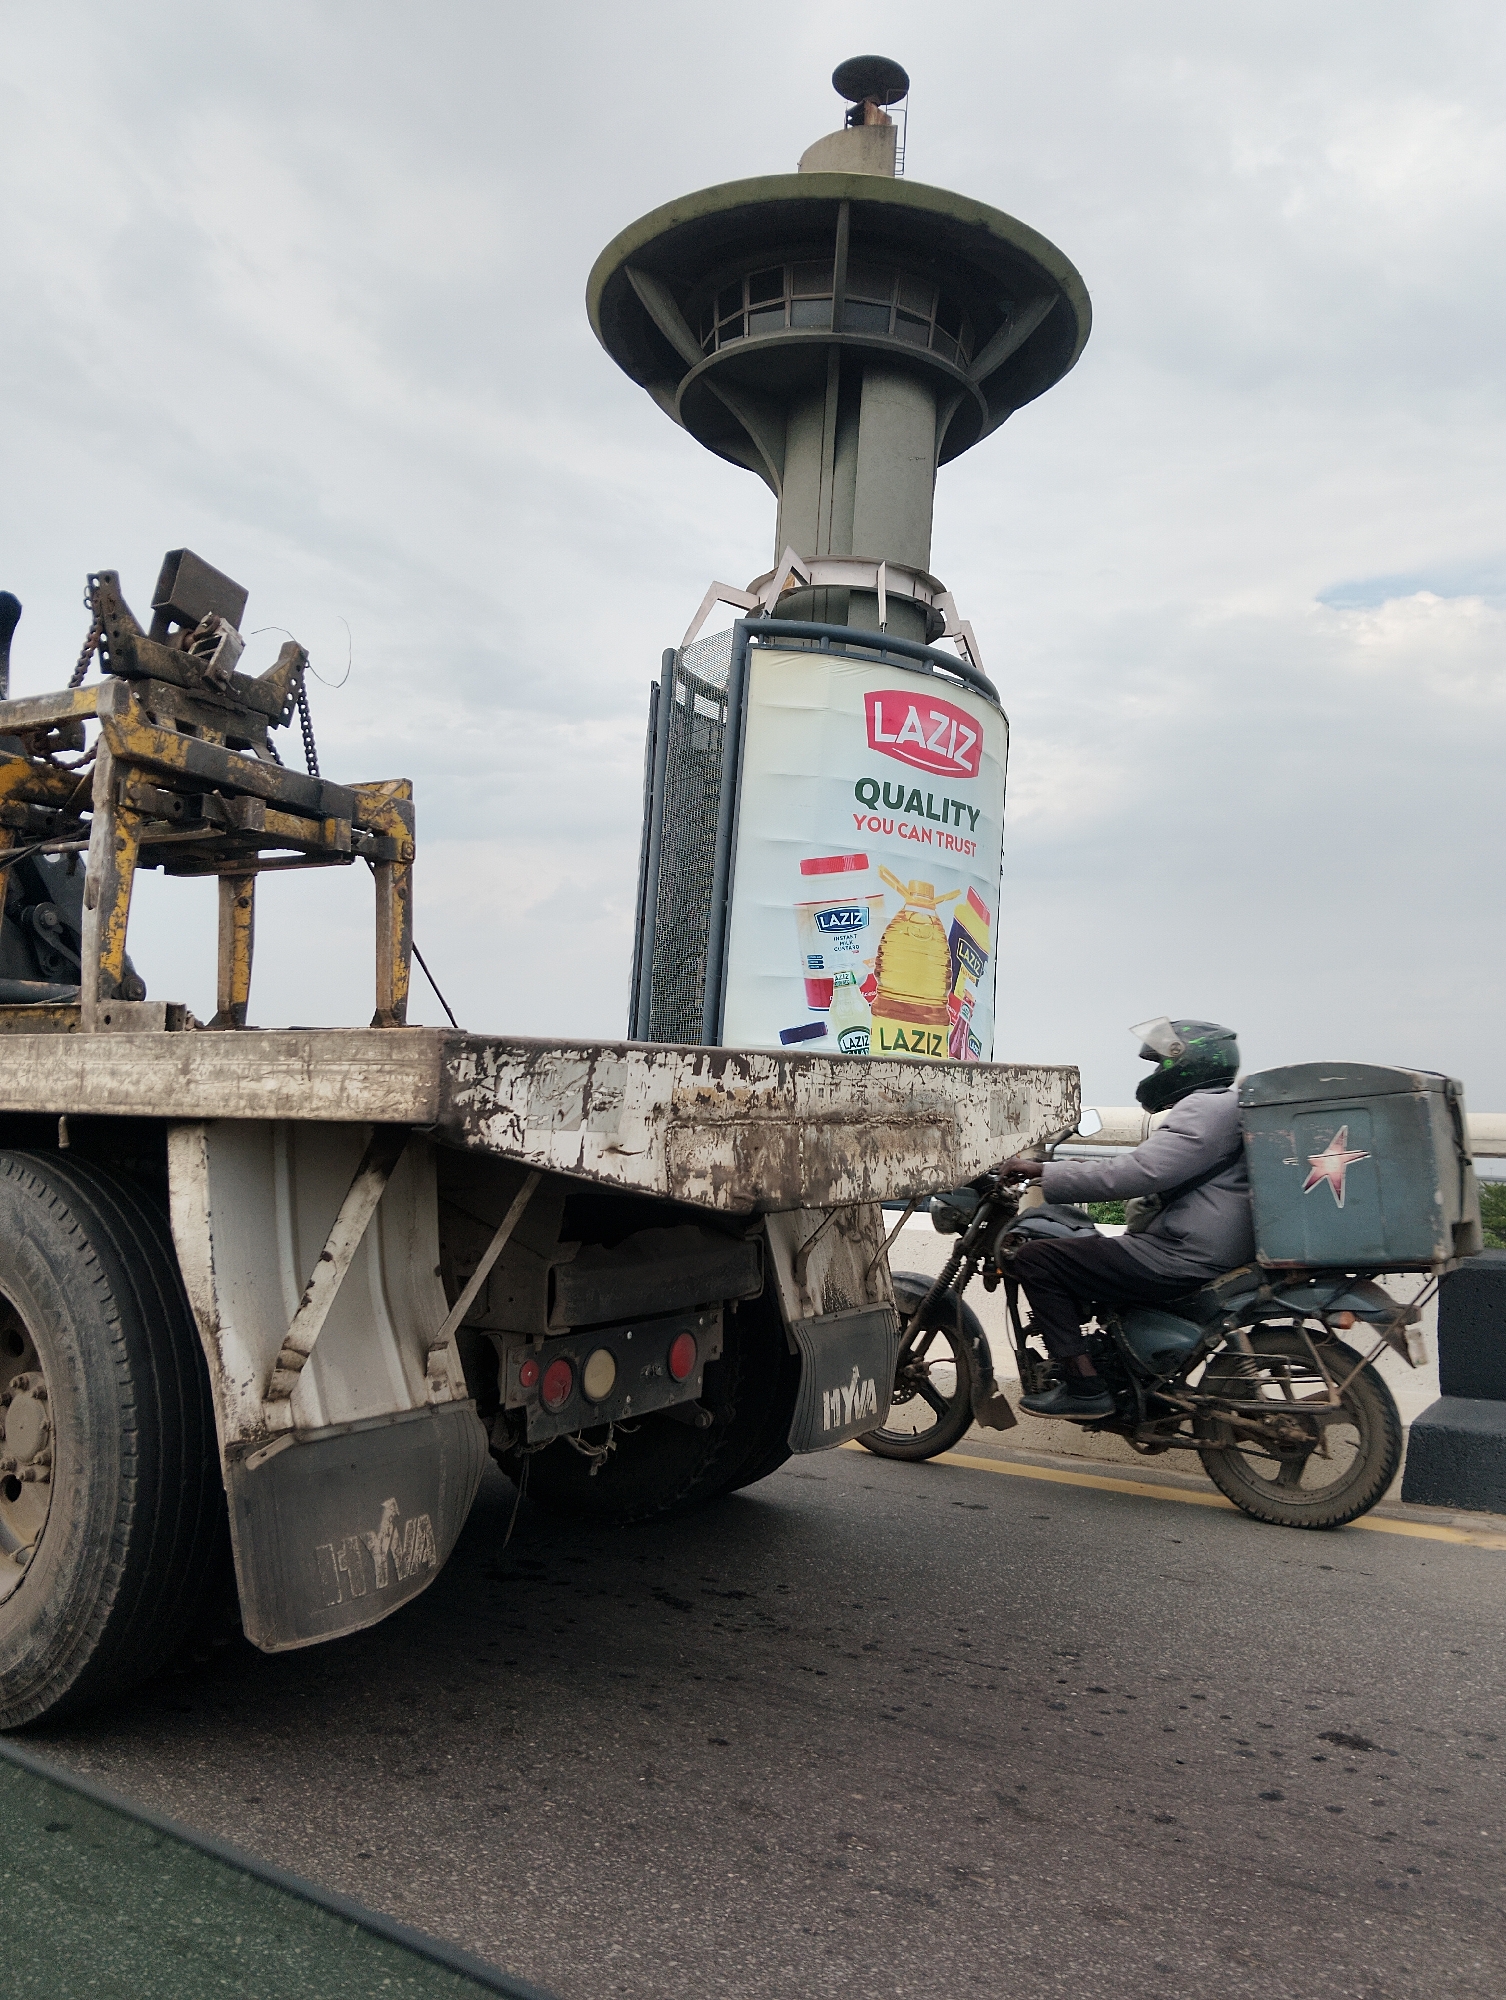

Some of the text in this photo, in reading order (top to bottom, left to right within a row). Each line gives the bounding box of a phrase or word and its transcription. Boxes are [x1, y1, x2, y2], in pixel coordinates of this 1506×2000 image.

[874, 701, 977, 772] LAZIZ
[854, 777, 981, 832] QUALITY
[852, 813, 977, 858] YOU CAN TRUST
[820, 912, 863, 928] LAZIZ
[833, 933, 858, 941] INSTANT
[833, 944, 860, 952] CUSTARD
[958, 942, 981, 976] LAZIZ
[842, 1035, 870, 1050] LAZIZ
[879, 1026, 943, 1058] LAZIZ
